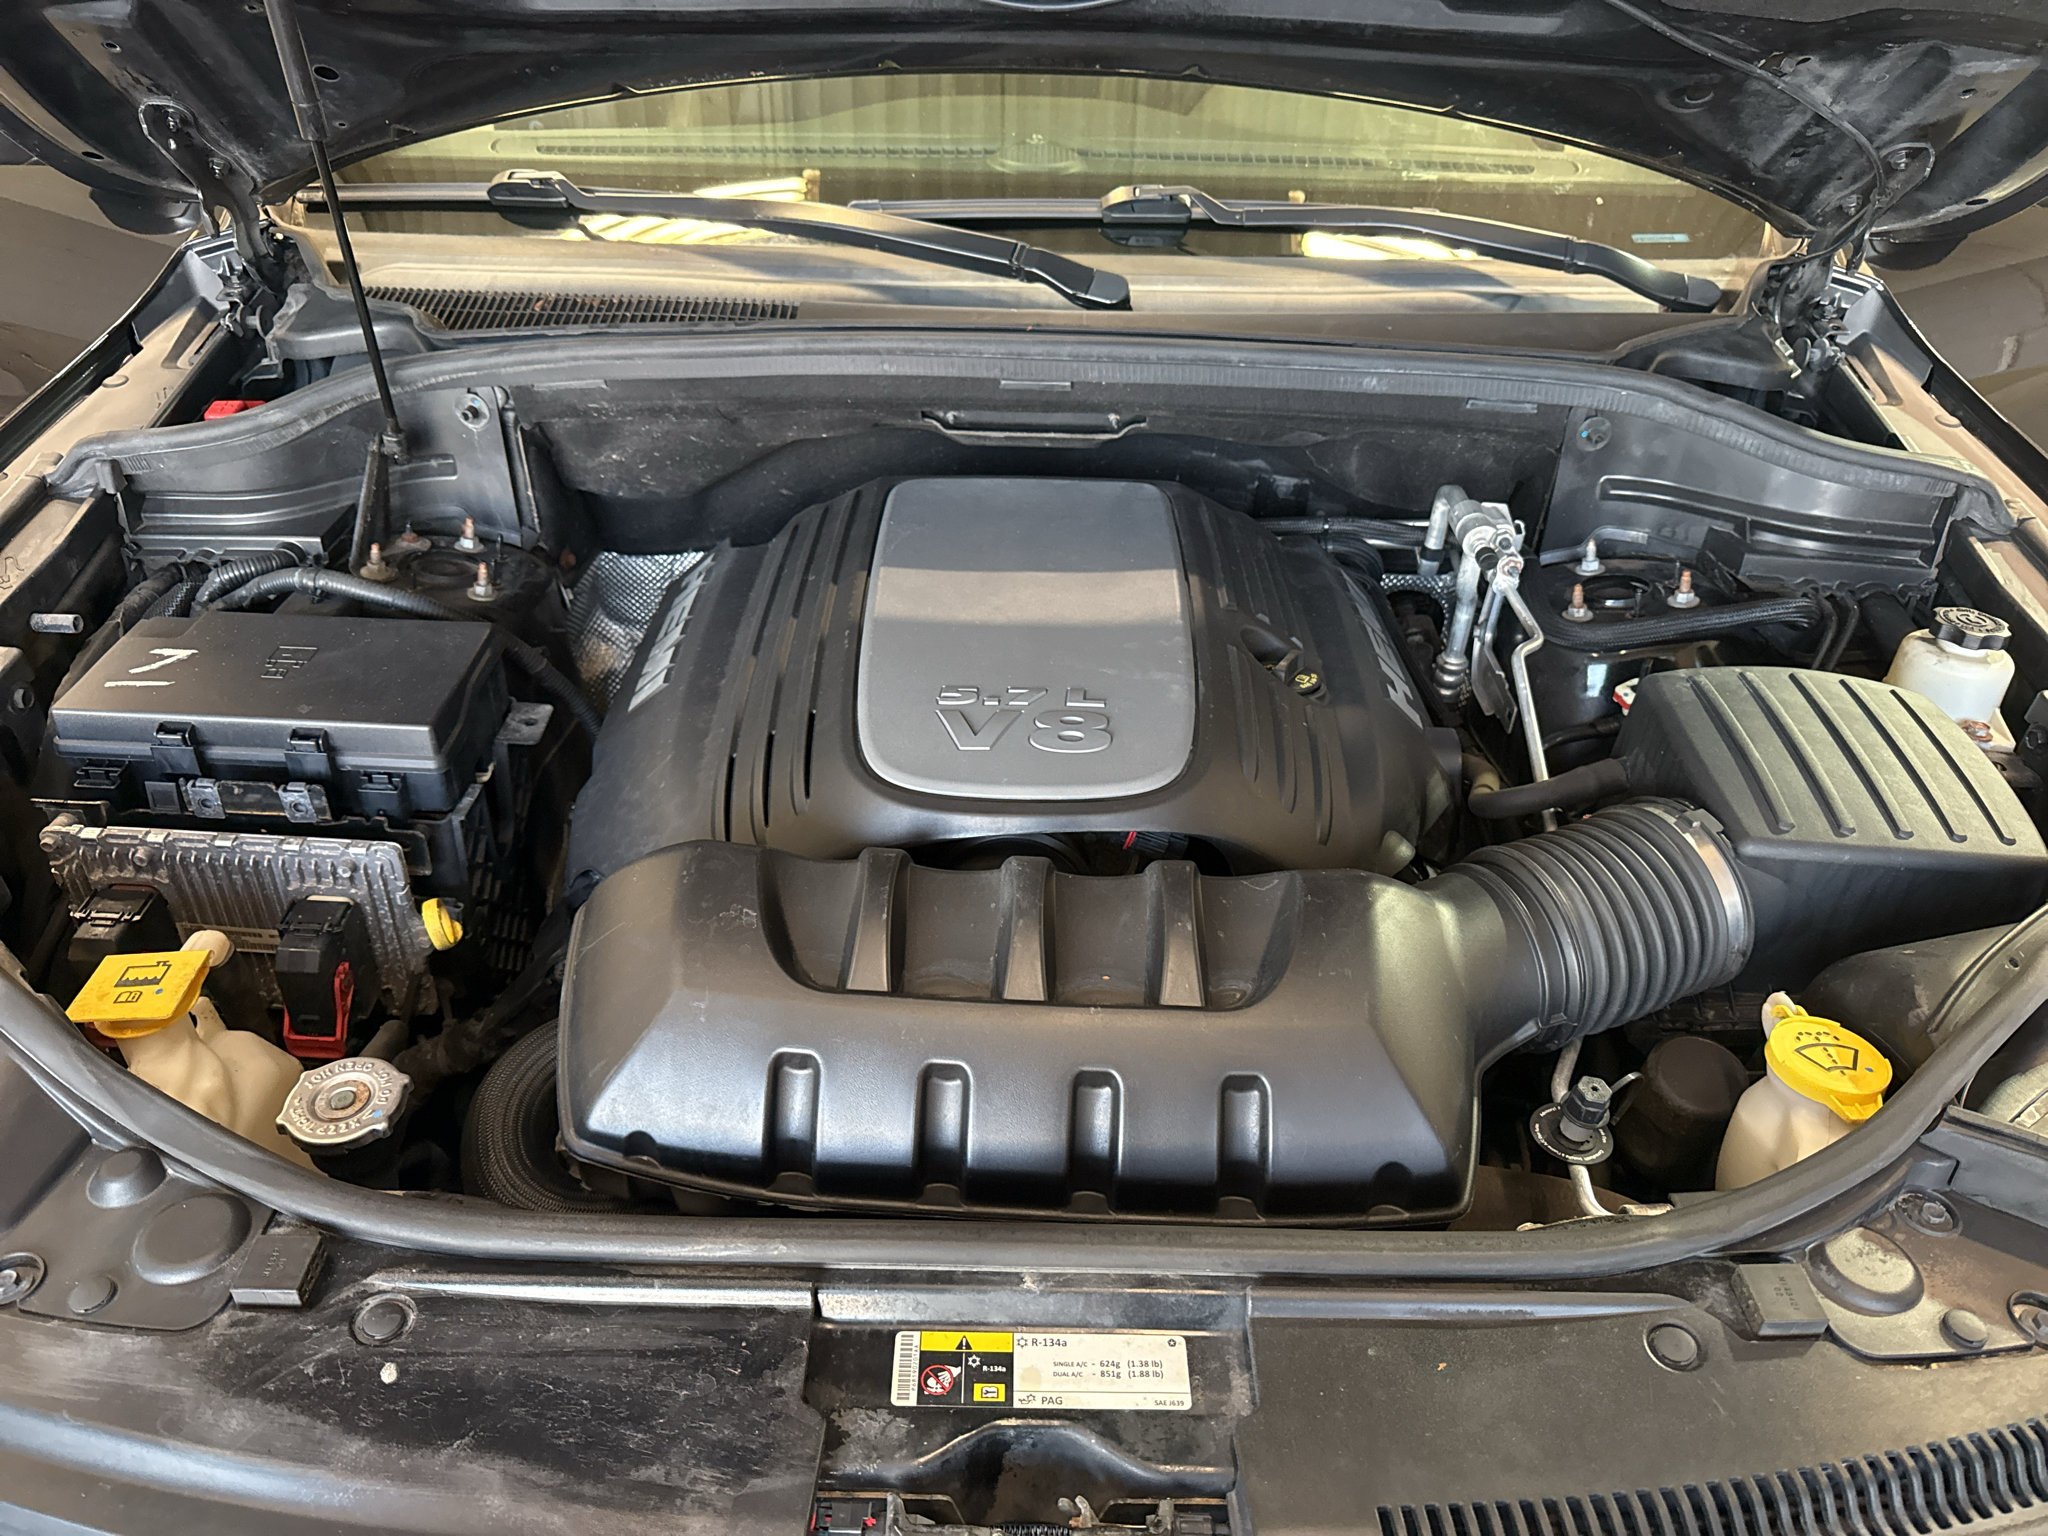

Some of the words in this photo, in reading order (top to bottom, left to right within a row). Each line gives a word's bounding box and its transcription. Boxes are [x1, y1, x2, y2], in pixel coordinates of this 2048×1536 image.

[934, 708, 1114, 754] V8
[1031, 1338, 1068, 1347] R-134a
[982, 1365, 1007, 1373] R-134a
[1099, 1360, 1121, 1369] 624g
[1127, 1360, 1149, 1369] (1.38
[1151, 1360, 1163, 1369] lb)
[1100, 1370, 1122, 1379] 851g
[1128, 1370, 1150, 1380] (1.88
[1152, 1370, 1164, 1380] lb)
[1041, 1396, 1064, 1405] PAG
